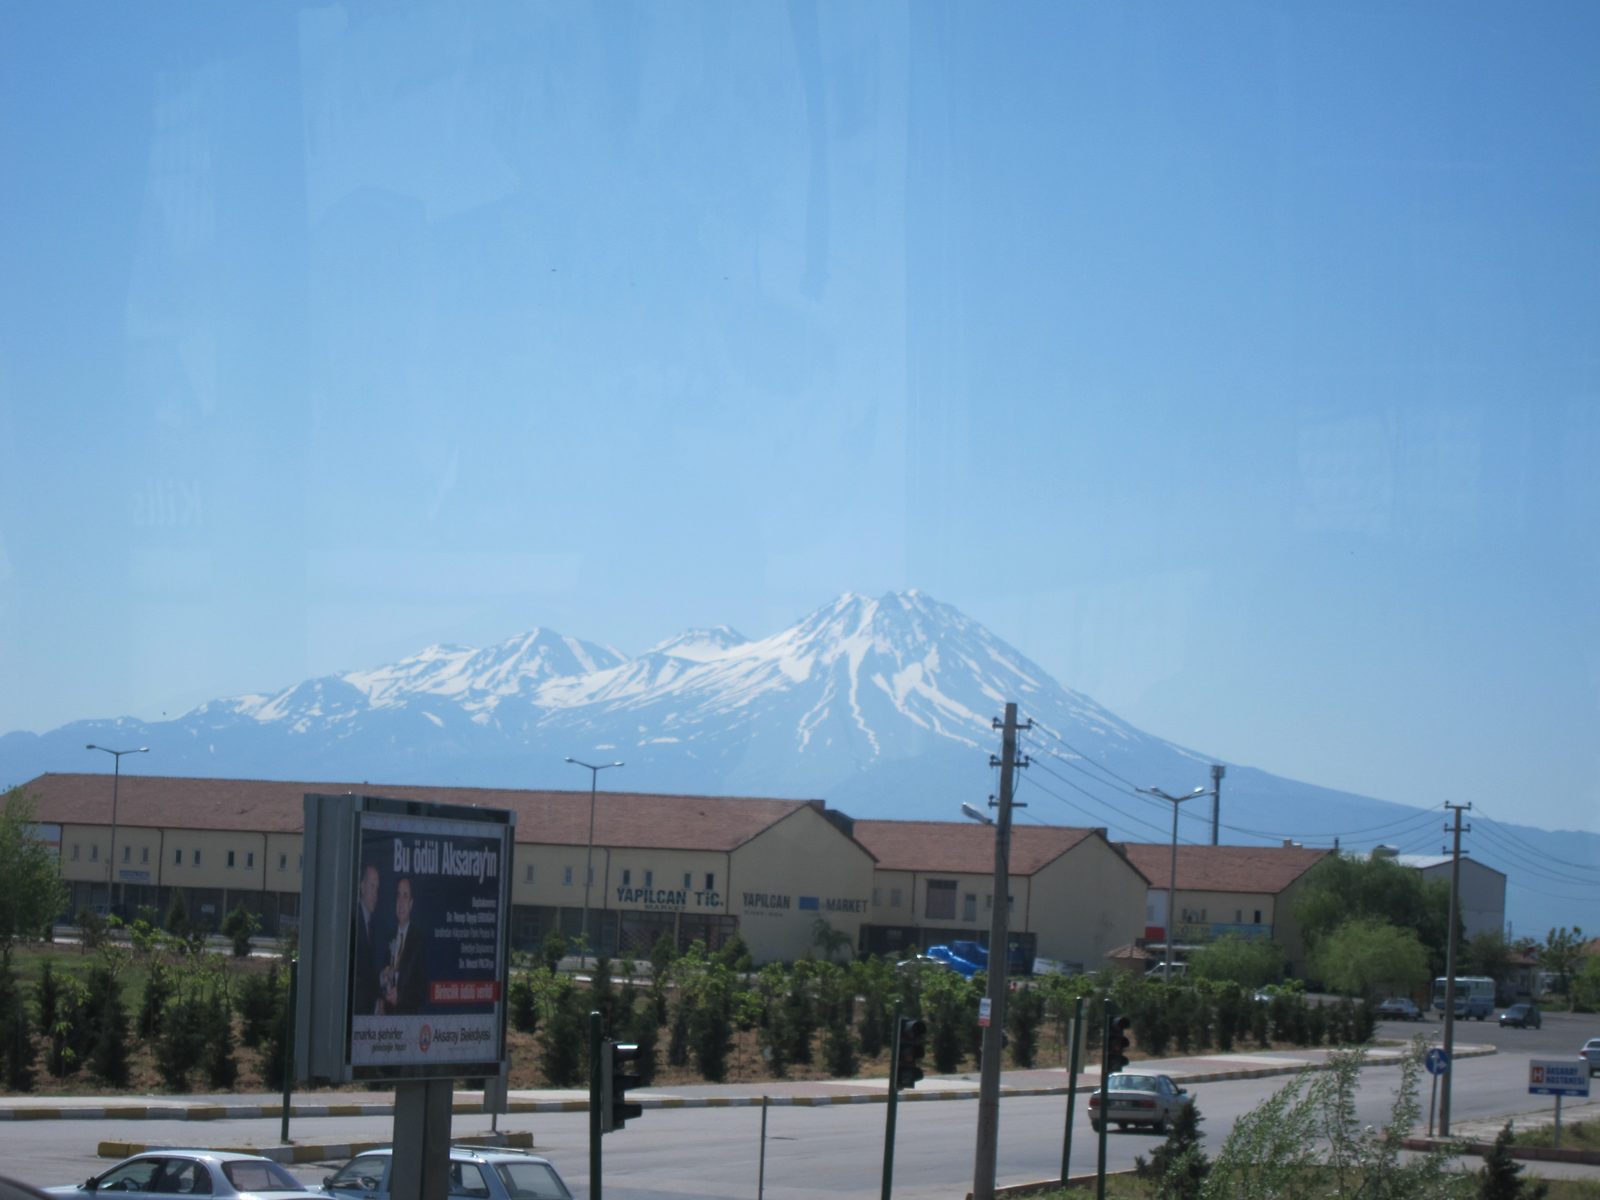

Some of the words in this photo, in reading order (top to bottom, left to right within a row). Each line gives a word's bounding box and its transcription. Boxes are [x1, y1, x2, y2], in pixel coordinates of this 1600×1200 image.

[393, 838, 410, 873] Bu
[413, 840, 439, 874] ödül
[616, 887, 687, 905] YAPILCAN
[742, 892, 790, 909] YAPILCAN
[826, 898, 868, 914] MARKET
[354, 1028, 377, 1040] marka
[432, 1028, 458, 1045] Aksaray
[460, 1027, 491, 1044] Belediyesi
